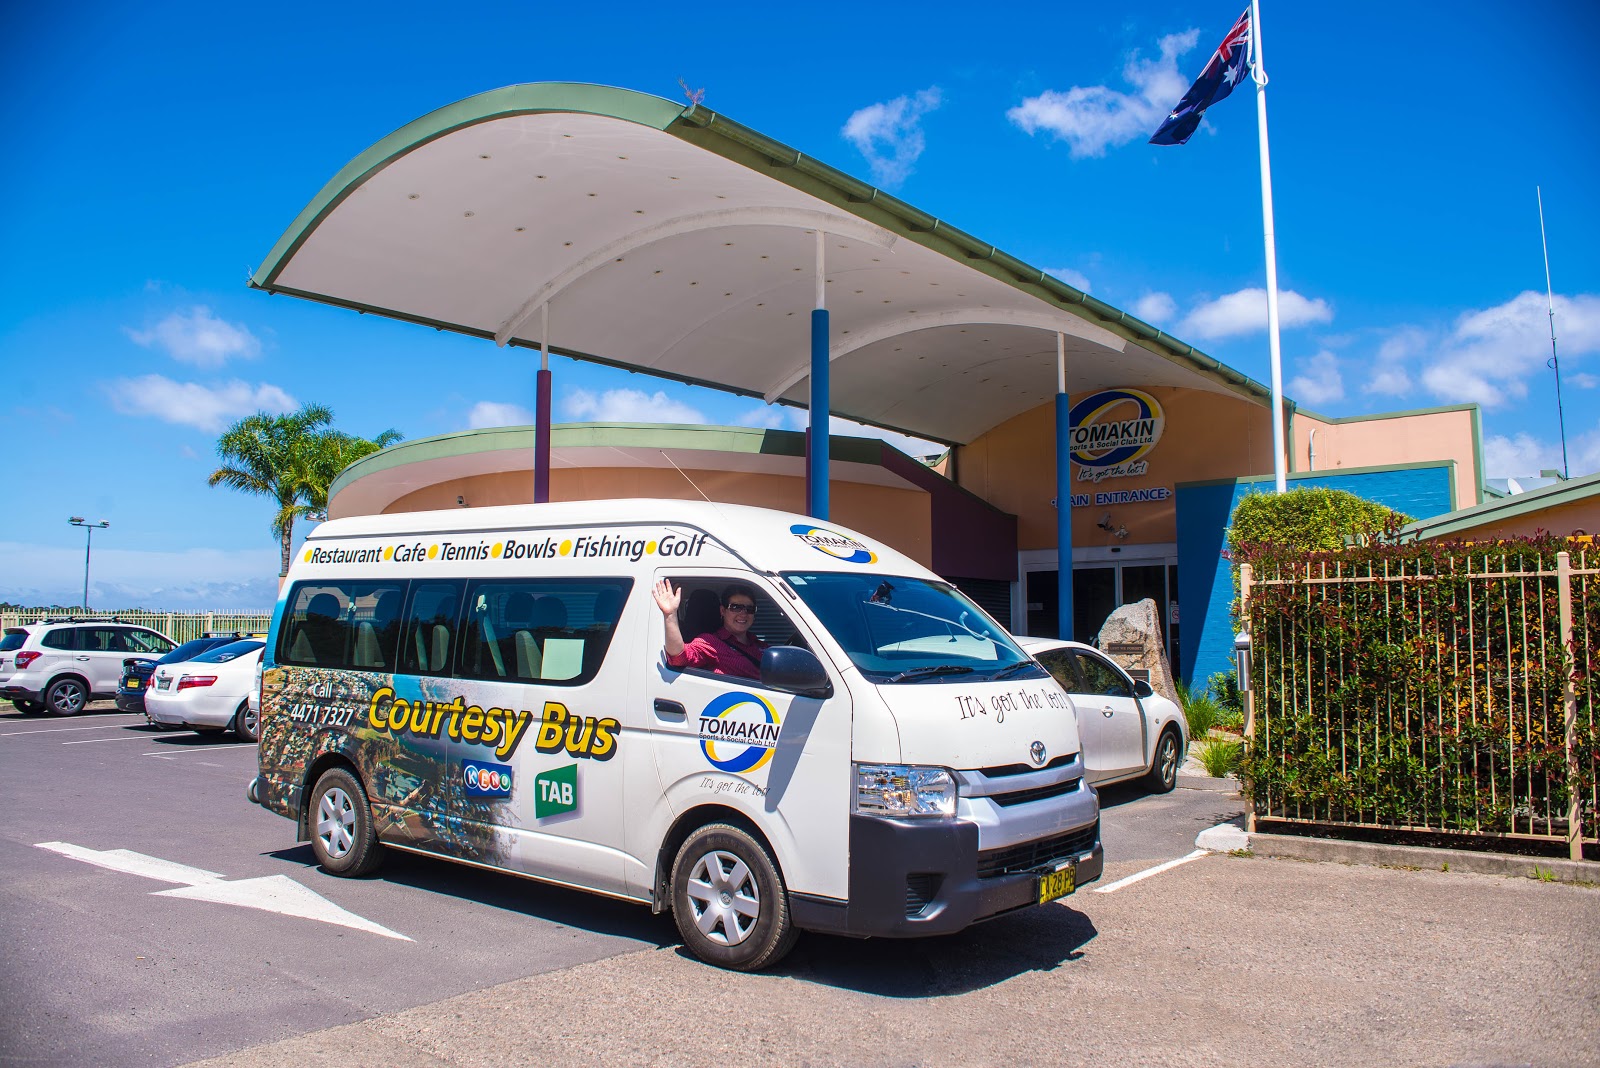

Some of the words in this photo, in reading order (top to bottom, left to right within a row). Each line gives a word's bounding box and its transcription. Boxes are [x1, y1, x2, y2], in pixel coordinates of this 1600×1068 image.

[1095, 469, 1109, 480] got
[1110, 466, 1125, 476] the
[1070, 495, 1089, 506] AIN
[1096, 488, 1165, 504] ENTRANCE
[311, 547, 382, 564] Restaurant
[393, 543, 426, 562] Cafe
[440, 541, 490, 561] Tennis
[503, 538, 557, 559] Bowls
[573, 535, 645, 562] Fishing
[658, 534, 708, 557] Golf
[313, 682, 332, 698] Call
[290, 704, 320, 723] 4471
[322, 706, 354, 727] 7327
[955, 695, 987, 720] It's
[991, 692, 1018, 724] got
[1018, 688, 1043, 710] the
[368, 687, 532, 761] Courtesy
[536, 701, 621, 761] Bus
[699, 718, 780, 741] TOMAKIN
[699, 733, 718, 741] Sports
[726, 736, 746, 744] Social
[467, 769, 509, 788] KENO
[714, 781, 733, 794] got
[734, 782, 750, 795] the
[538, 779, 573, 806] TAB
